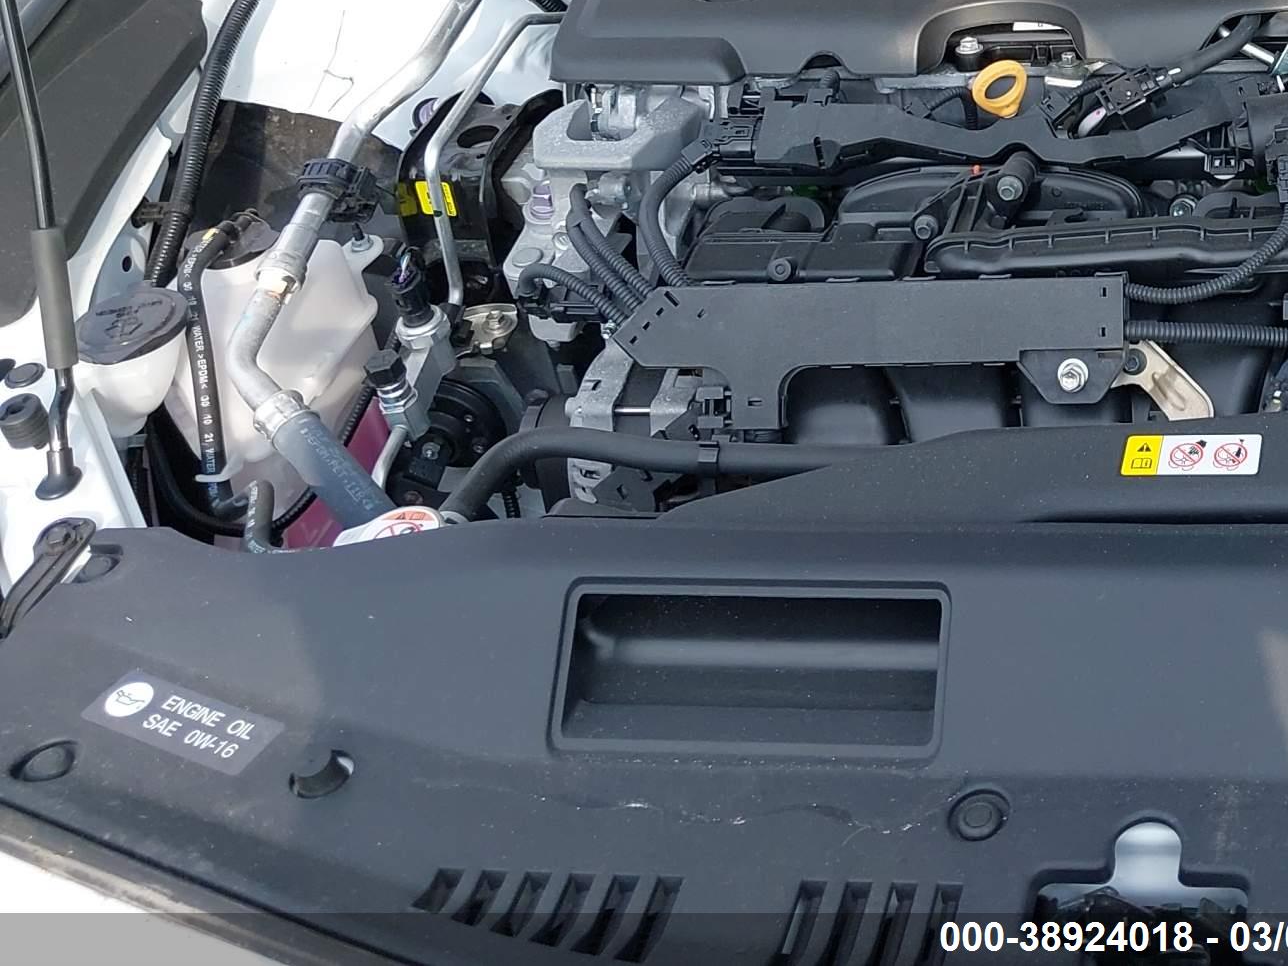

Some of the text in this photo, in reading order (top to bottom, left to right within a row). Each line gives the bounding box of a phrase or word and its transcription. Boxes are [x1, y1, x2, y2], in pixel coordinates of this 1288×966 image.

[192, 325, 205, 352] WATER
[198, 353, 209, 390] >EPDM<
[202, 414, 213, 426] 10
[204, 433, 215, 443] 21
[161, 695, 256, 740] ENGINE OIL
[142, 714, 240, 758] SAE 0W-16
